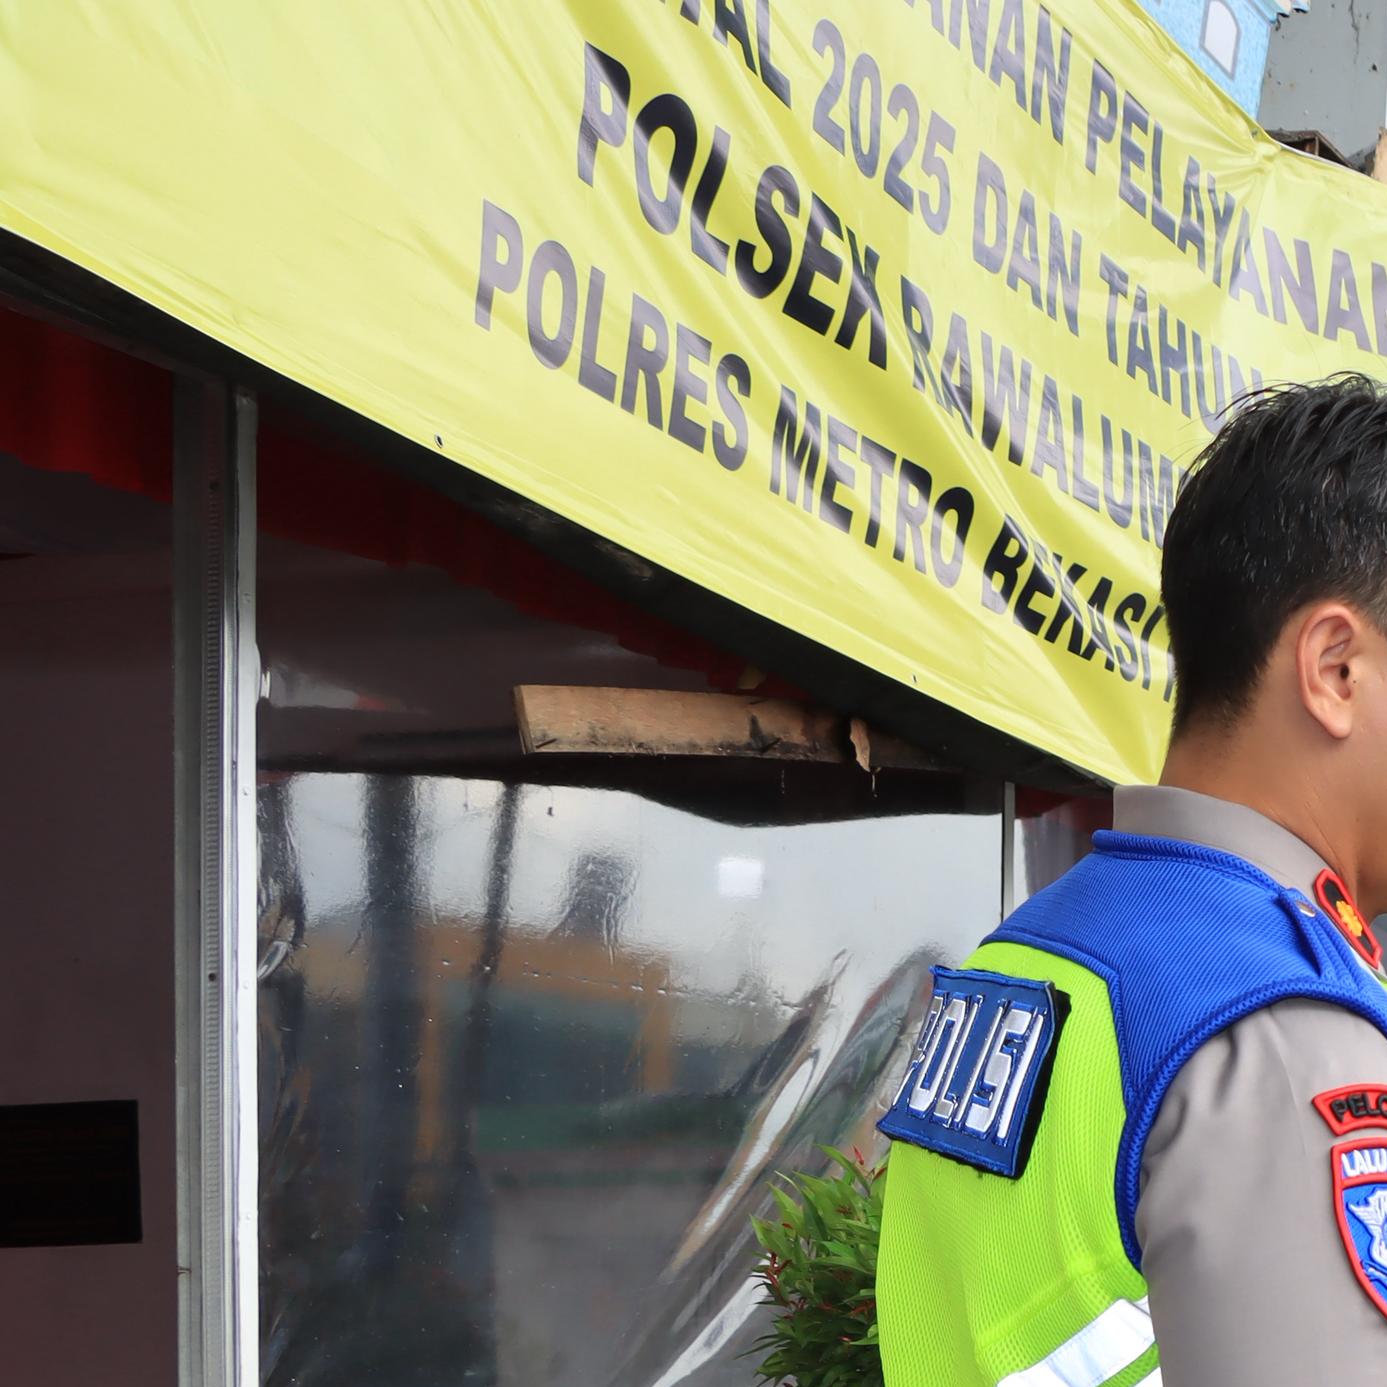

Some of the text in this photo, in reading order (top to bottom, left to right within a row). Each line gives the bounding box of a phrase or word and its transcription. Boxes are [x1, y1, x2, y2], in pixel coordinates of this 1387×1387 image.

[577, 40, 1187, 550] POLSEK RAWALUM
[812, 18, 956, 236] 2025
[972, 151, 1082, 338] DAN
[474, 198, 752, 472] POLRES
[768, 384, 975, 589] METRO
[981, 512, 1165, 690] BEKASI
[892, 992, 1046, 1147] POLISI
[1341, 1148, 1387, 1177] LALU
